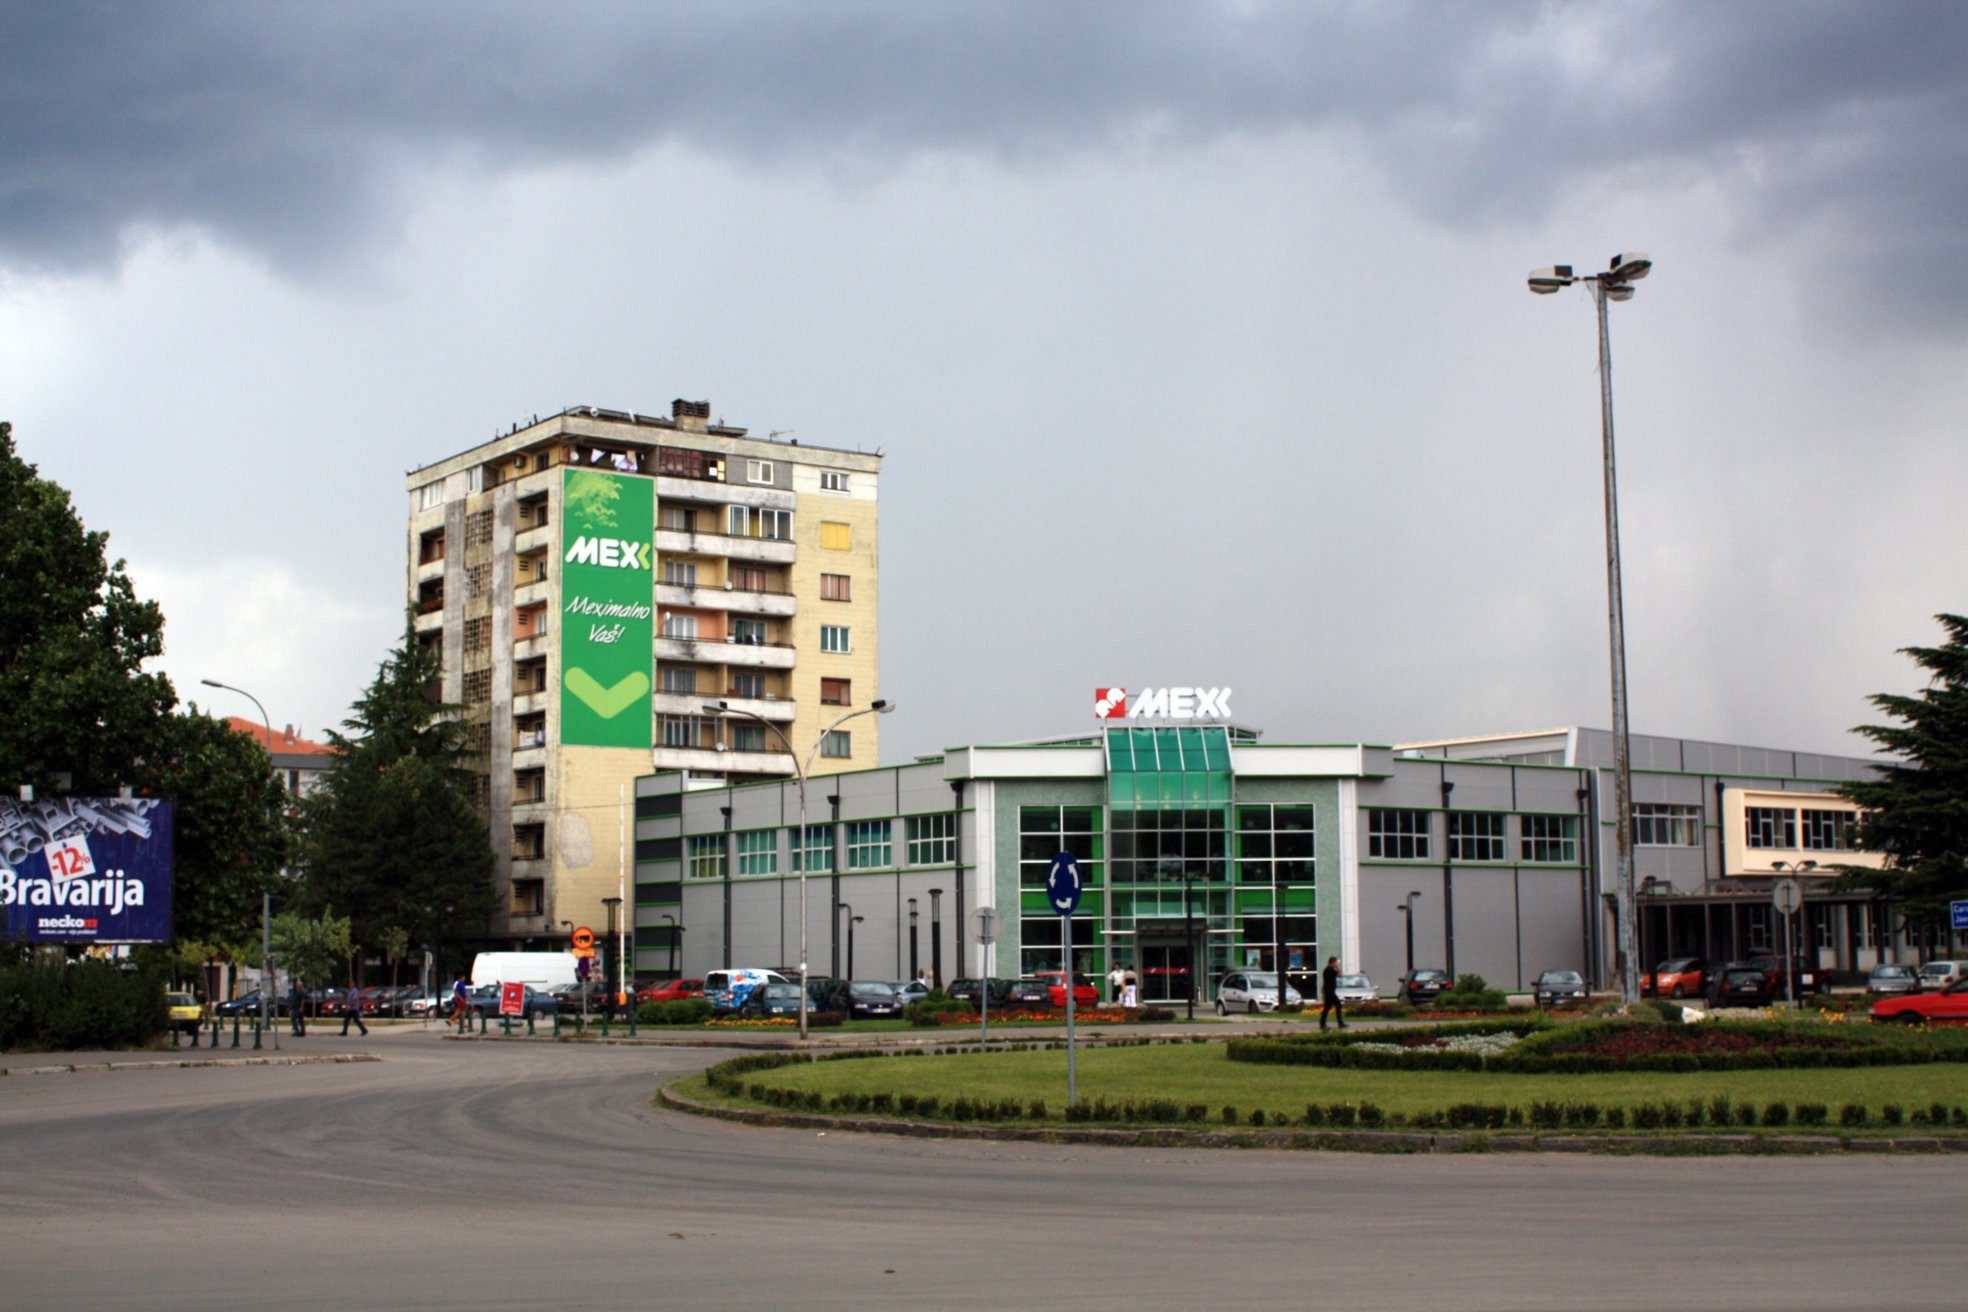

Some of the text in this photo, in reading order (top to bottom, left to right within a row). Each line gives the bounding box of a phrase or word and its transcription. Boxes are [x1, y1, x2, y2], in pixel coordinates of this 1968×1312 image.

[564, 595, 651, 619] Meximalno
[589, 623, 626, 643] Vaš!
[0, 869, 144, 915] Bravarija
